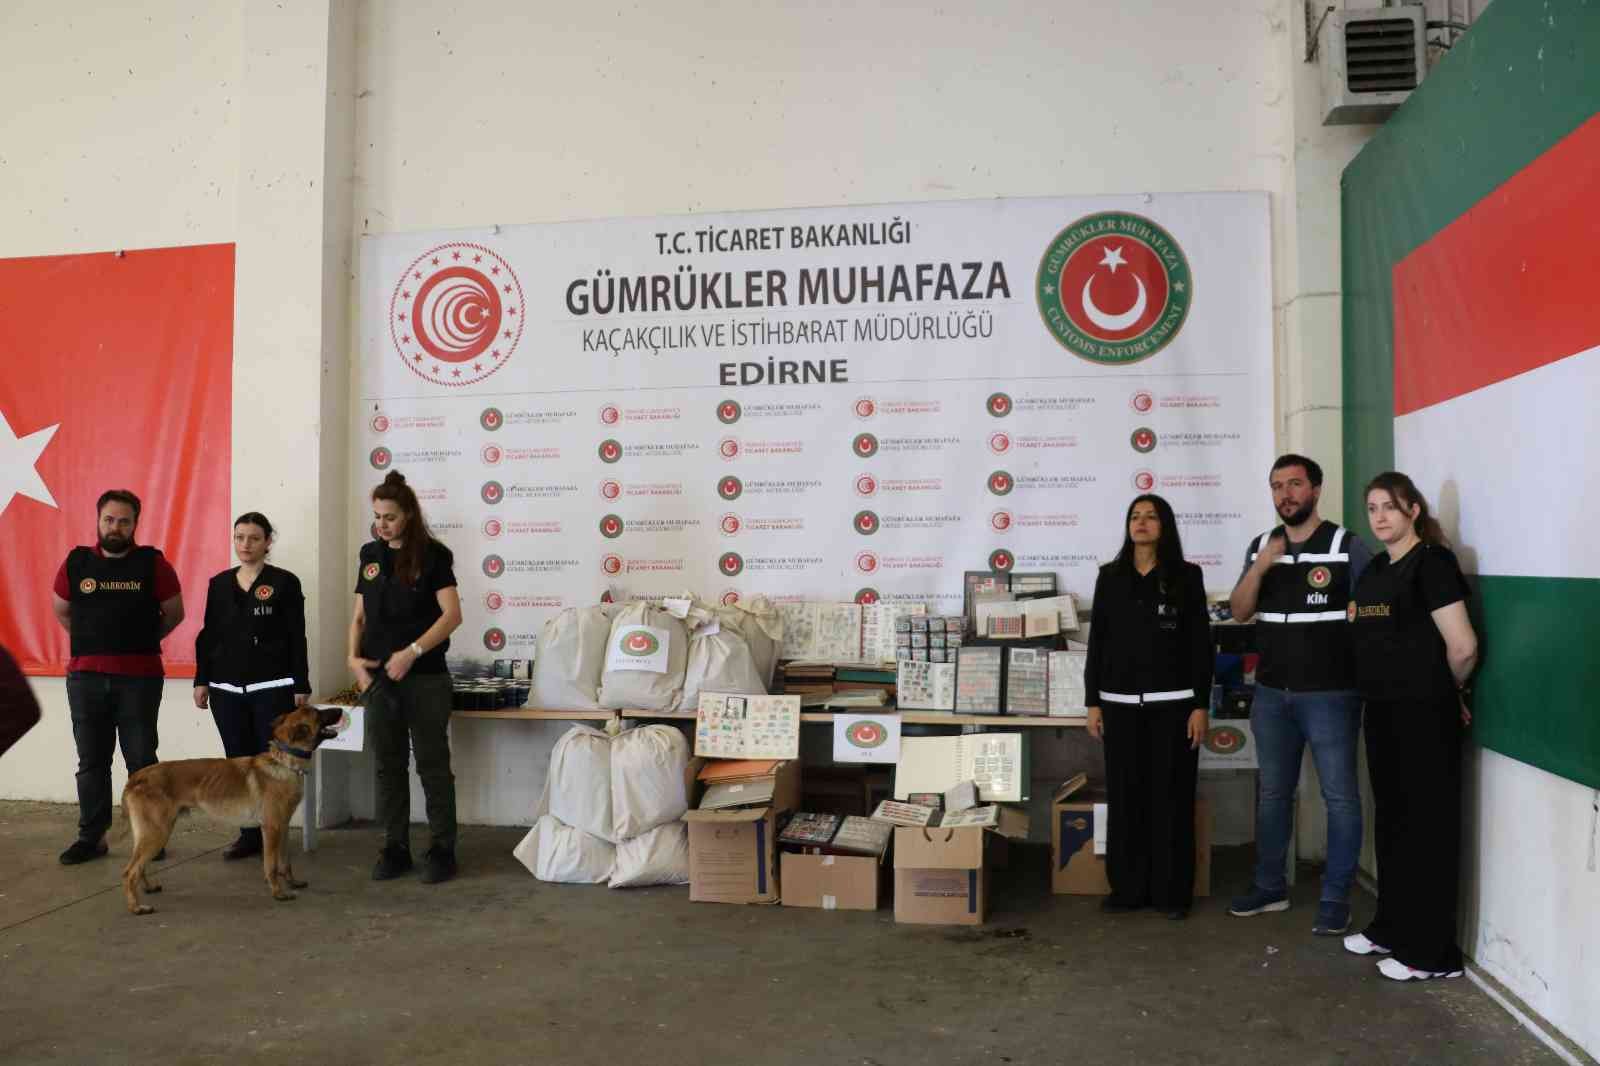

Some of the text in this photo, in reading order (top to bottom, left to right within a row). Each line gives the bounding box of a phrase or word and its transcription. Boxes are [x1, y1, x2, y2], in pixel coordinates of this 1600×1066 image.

[655, 216, 911, 255] T.C. TİCARET BAKANLIĞI
[566, 261, 1011, 316] GÜMRÜKLER MUHAFAZA
[583, 310, 993, 356] KAÇAKÇILIK VE İSTİHBARAT MÜDÜRLÜĞÜ
[719, 356, 849, 386] EDİRNE
[1306, 591, 1329, 605] KİM
